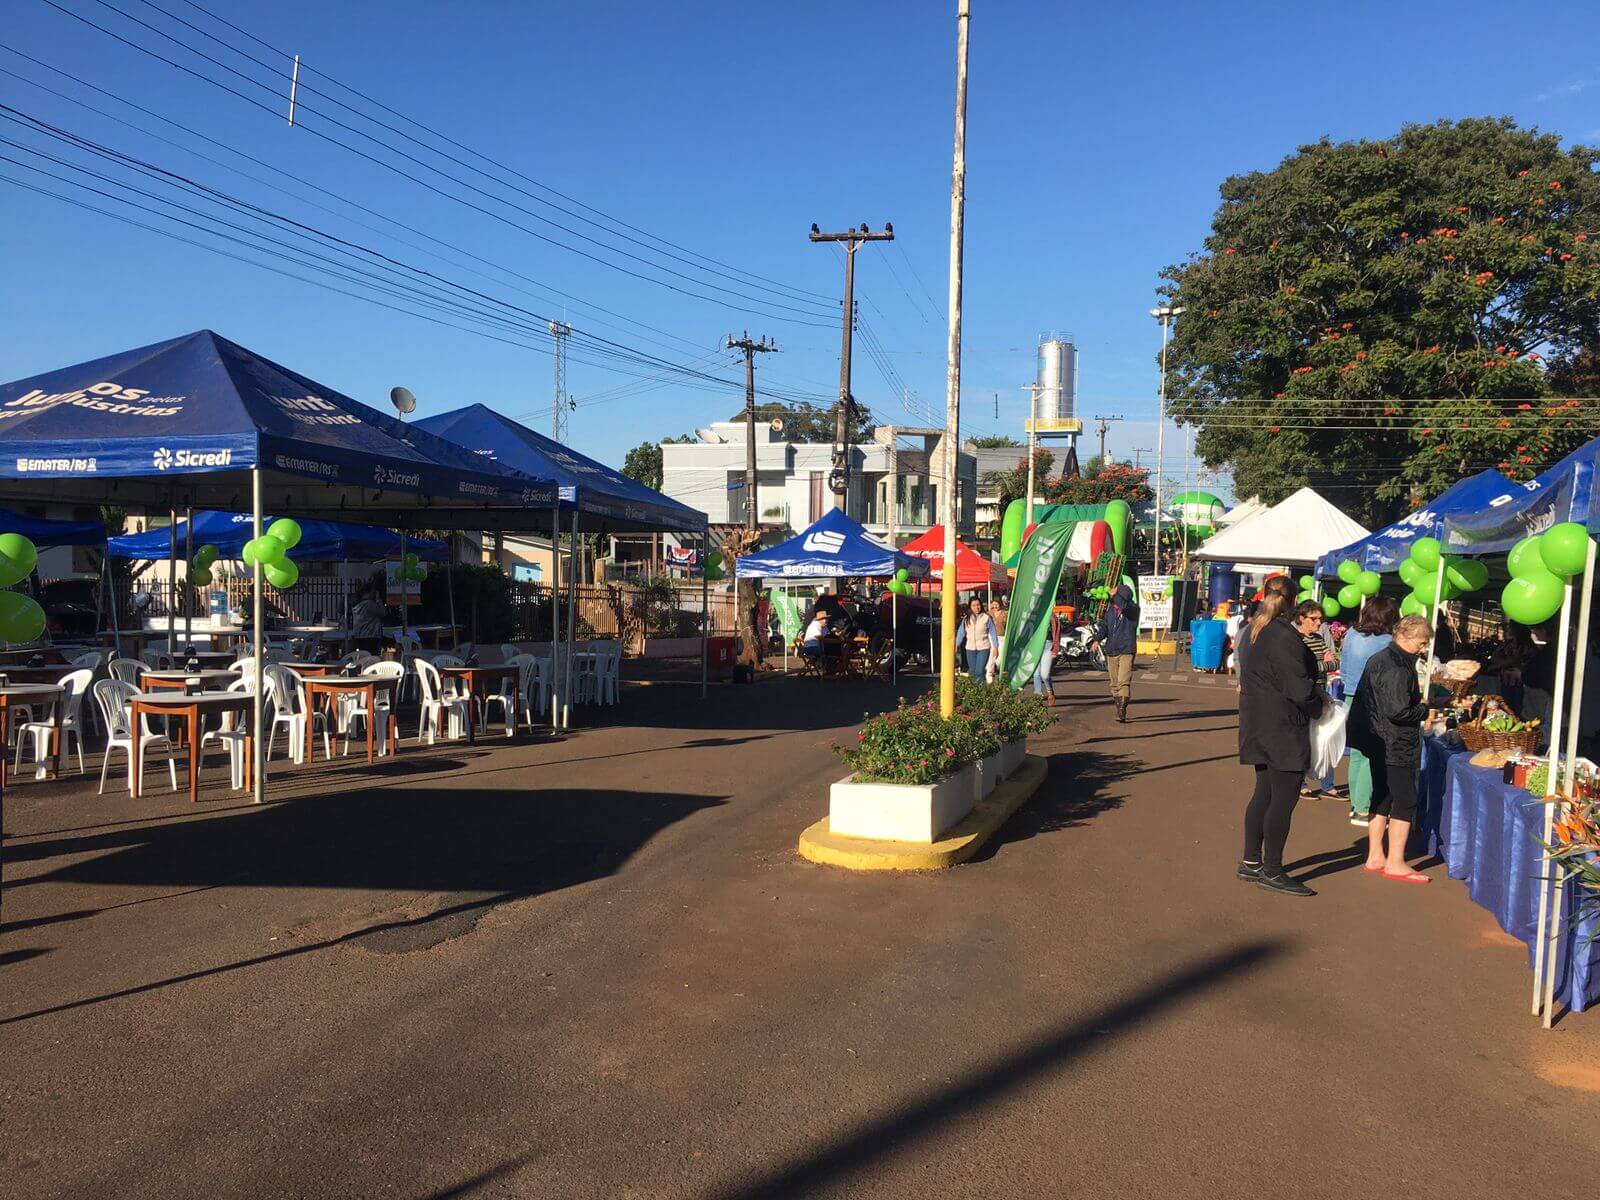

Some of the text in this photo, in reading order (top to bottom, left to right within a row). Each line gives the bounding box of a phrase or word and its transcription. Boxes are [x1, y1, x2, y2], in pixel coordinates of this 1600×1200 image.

[28, 458, 87, 471] EMATER/RS
[174, 448, 232, 467] Sicredi
[285, 457, 332, 476] EMATER/RS
[386, 469, 420, 487] Sicredi
